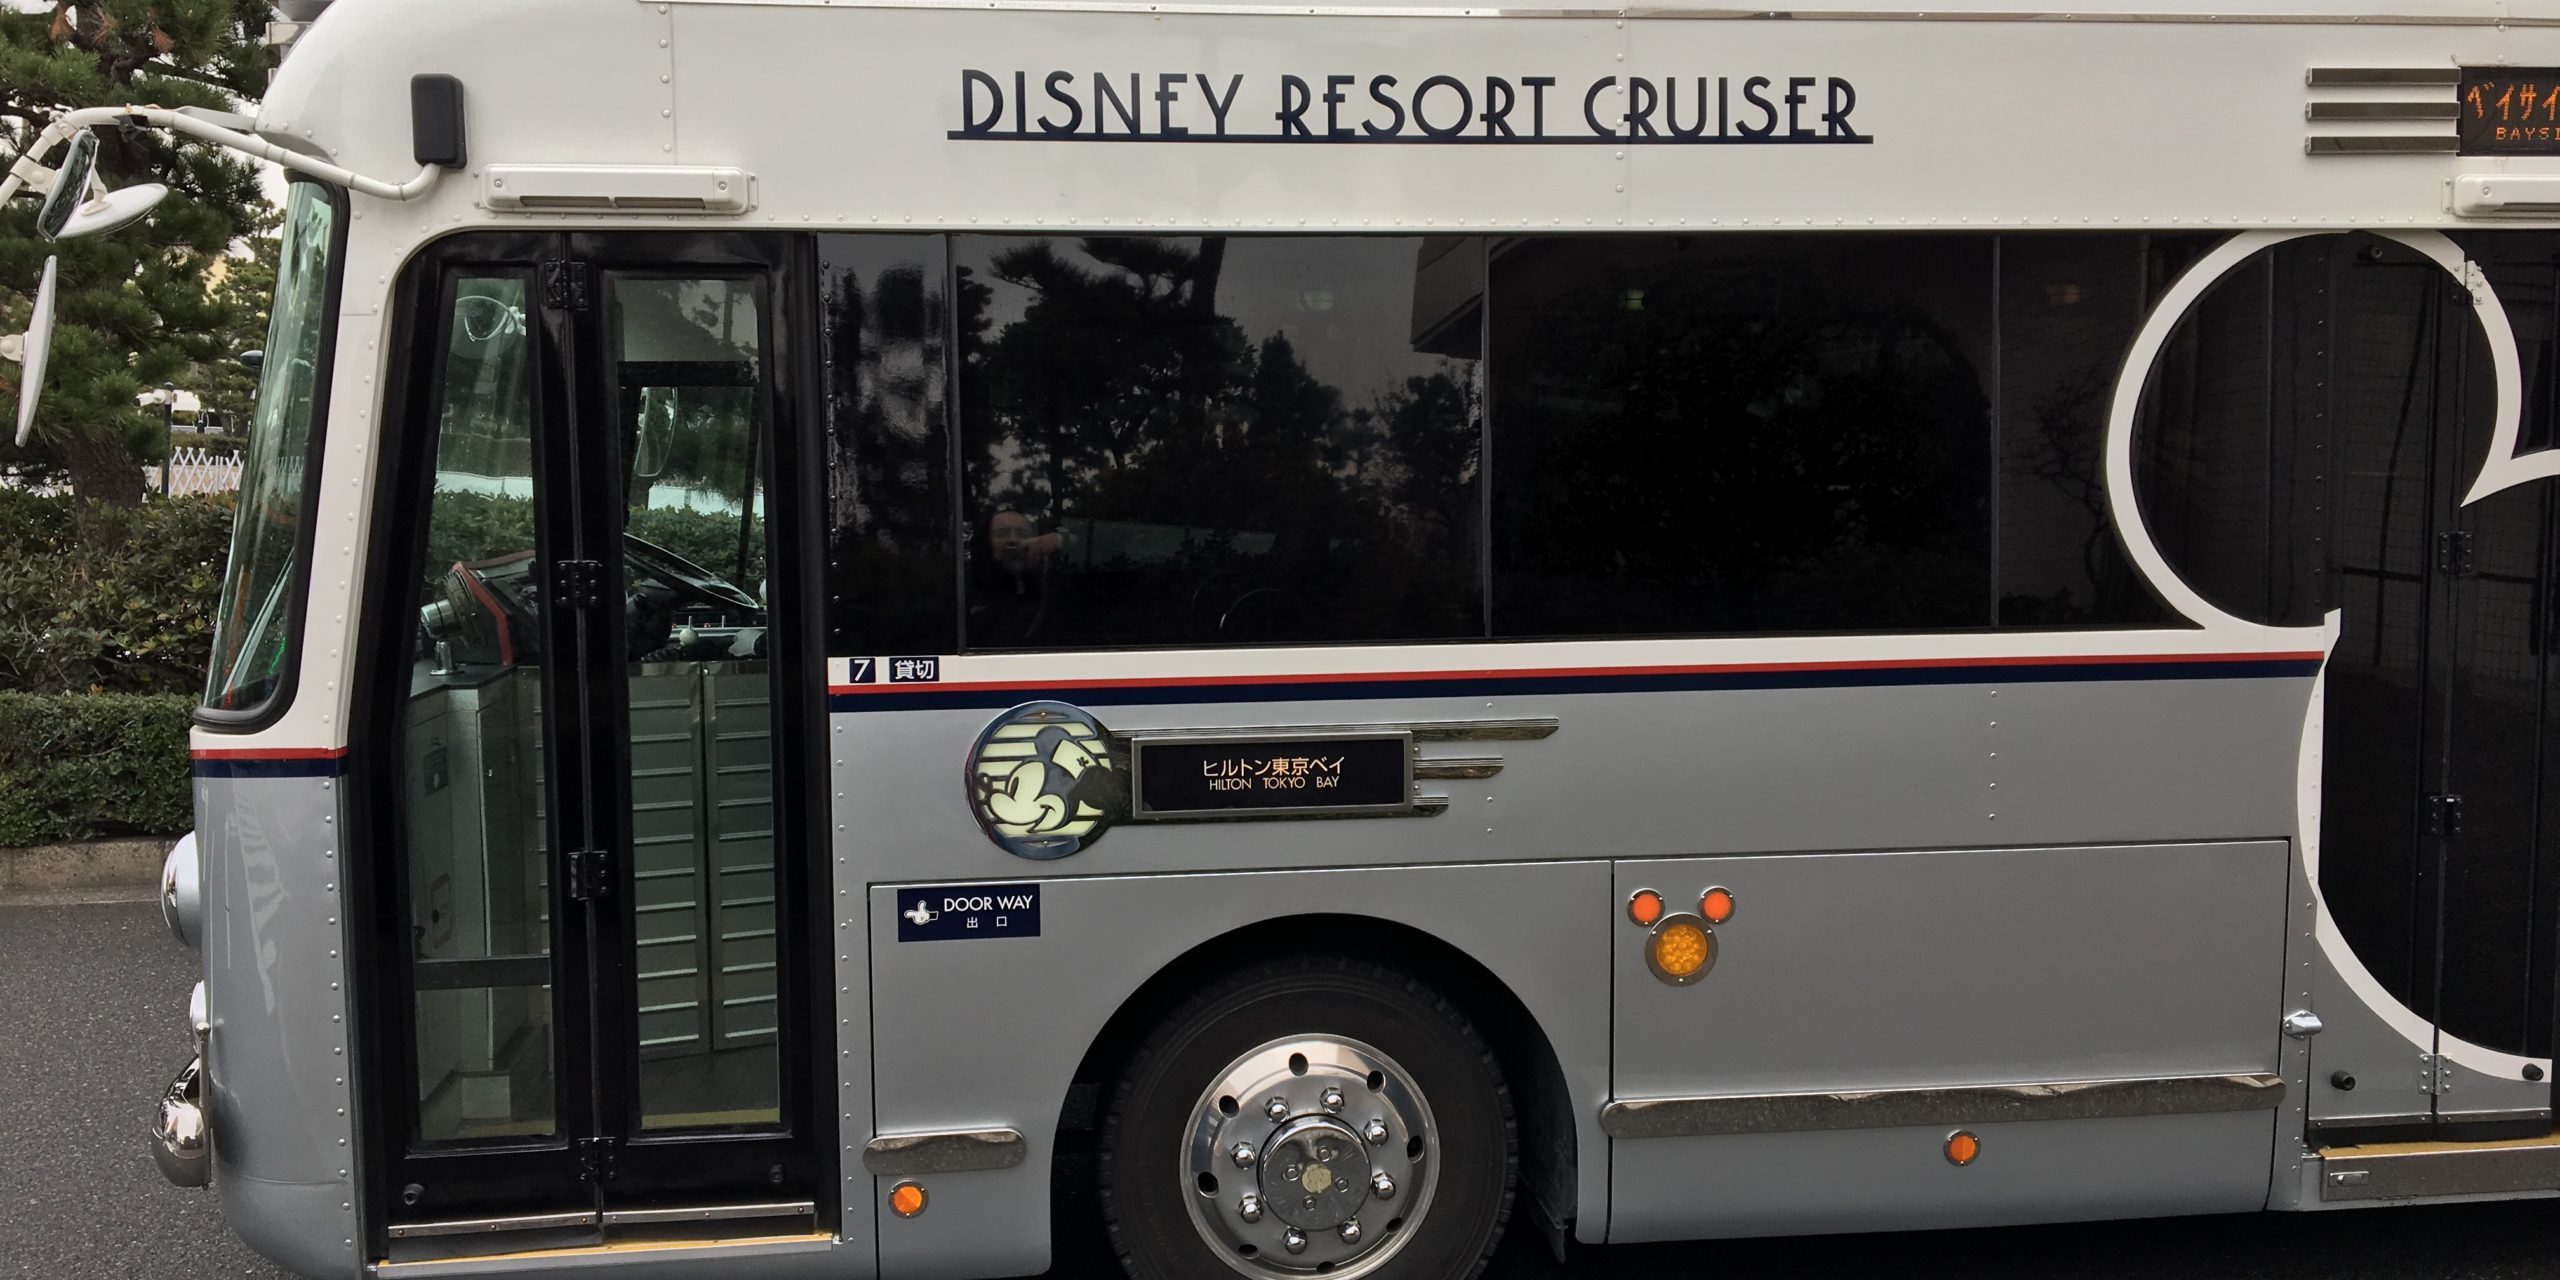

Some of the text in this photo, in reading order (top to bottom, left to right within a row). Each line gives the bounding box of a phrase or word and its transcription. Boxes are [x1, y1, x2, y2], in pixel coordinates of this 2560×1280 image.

[962, 69, 1857, 141] DISNEY RESORT CRUISER
[854, 660, 870, 681] 7
[894, 660, 934, 680] 貸切
[1204, 757, 1344, 777] ヒルトン東京ベイ
[1209, 776, 1339, 791] HILTON TOKYO BAY
[944, 895, 1033, 912] DOOR WAY
